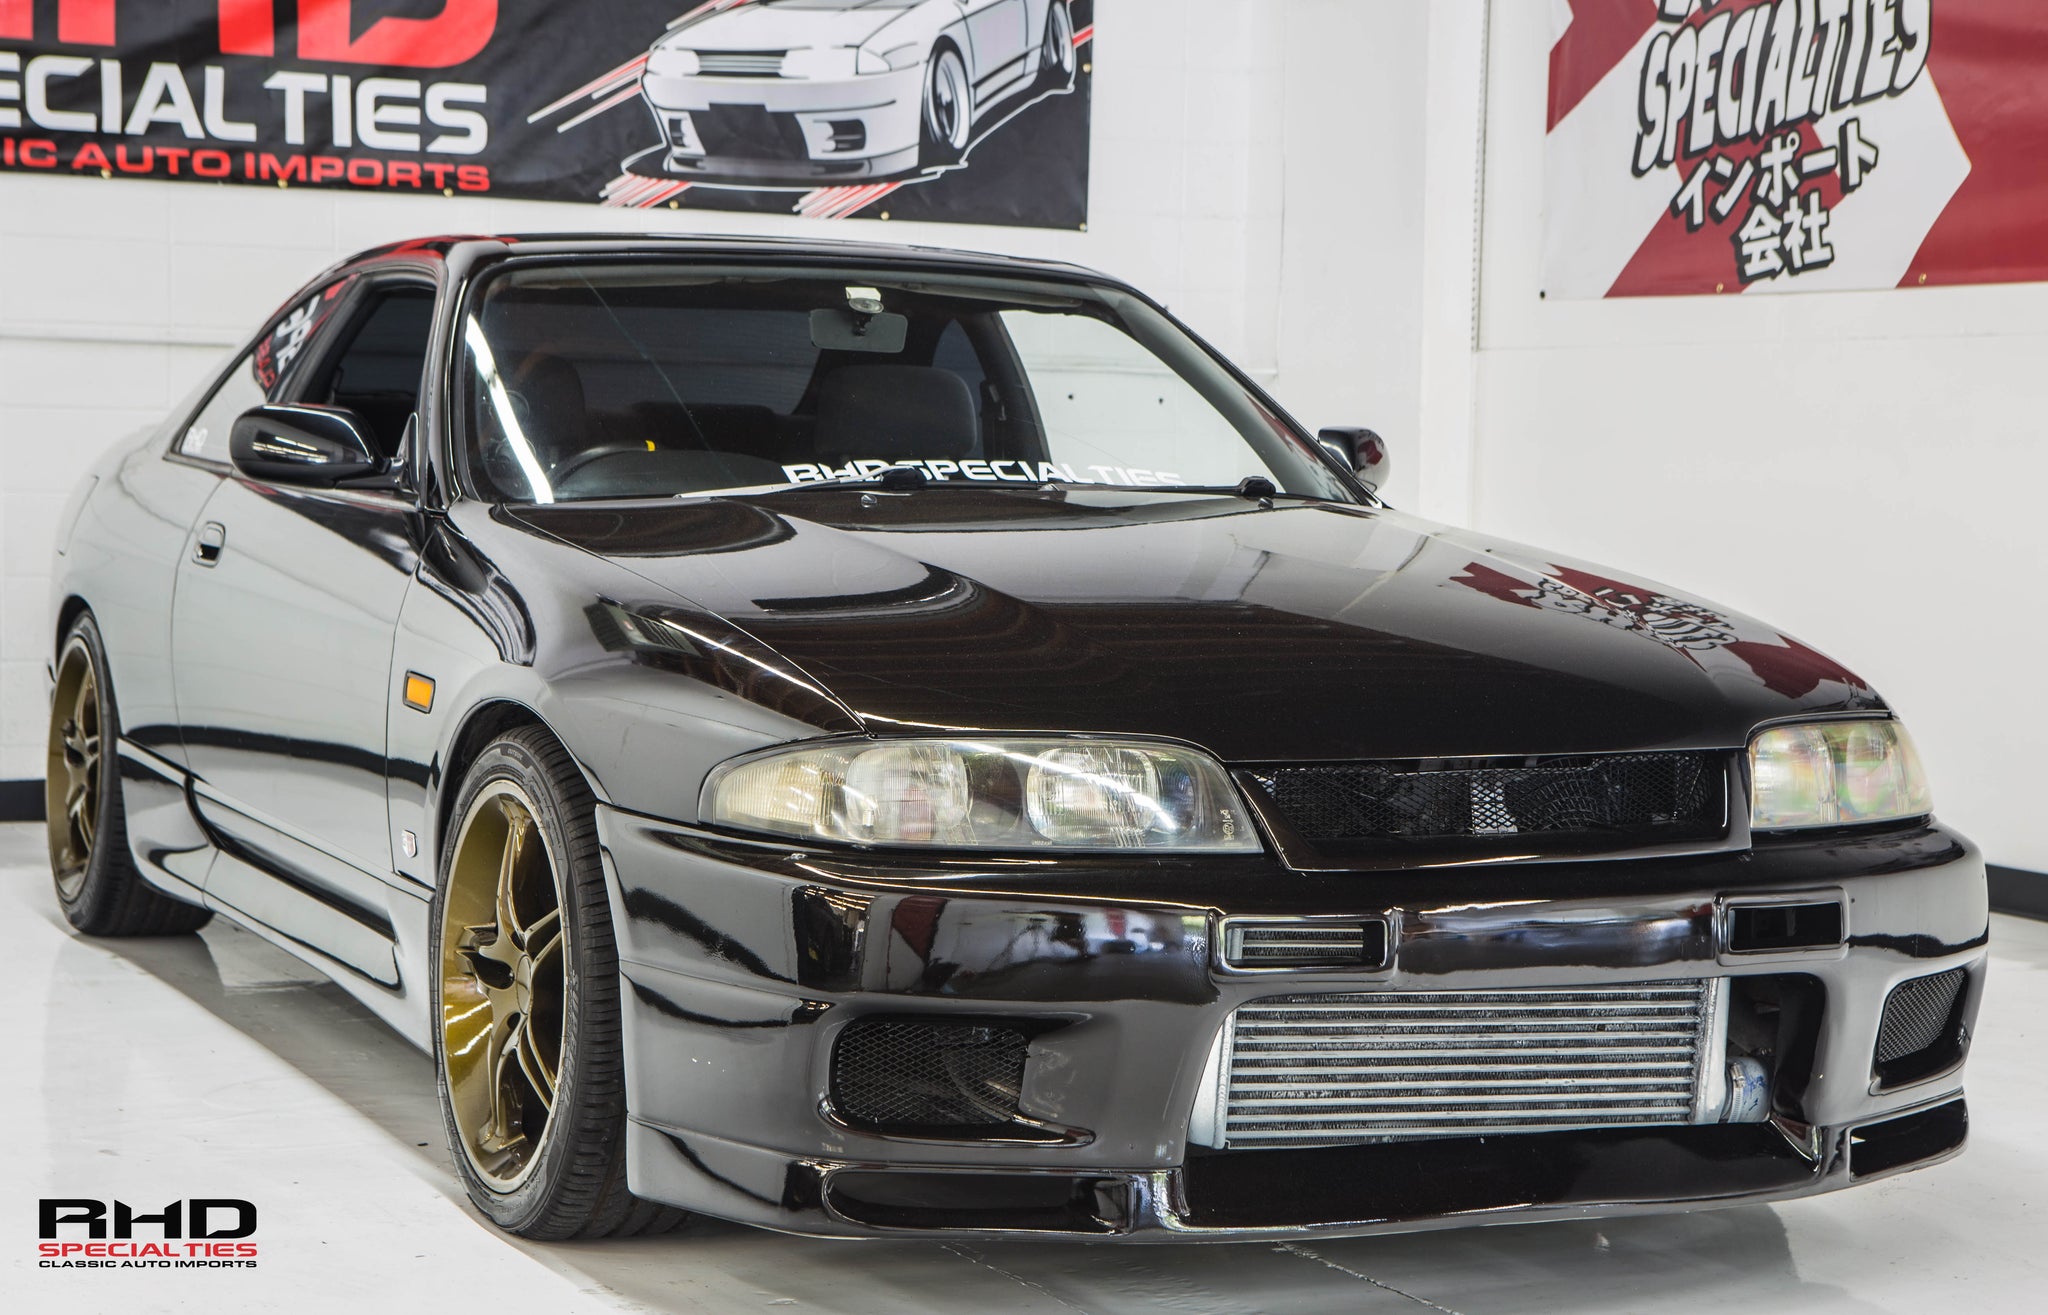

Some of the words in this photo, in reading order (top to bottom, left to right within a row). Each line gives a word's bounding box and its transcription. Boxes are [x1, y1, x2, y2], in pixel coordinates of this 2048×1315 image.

[1632, 0, 1932, 177] SPECIALTIES
[71, 142, 231, 177] AUTO
[244, 152, 491, 192] IMPORTS
[1671, 117, 1879, 232] インポート
[1734, 189, 1834, 281] 会社
